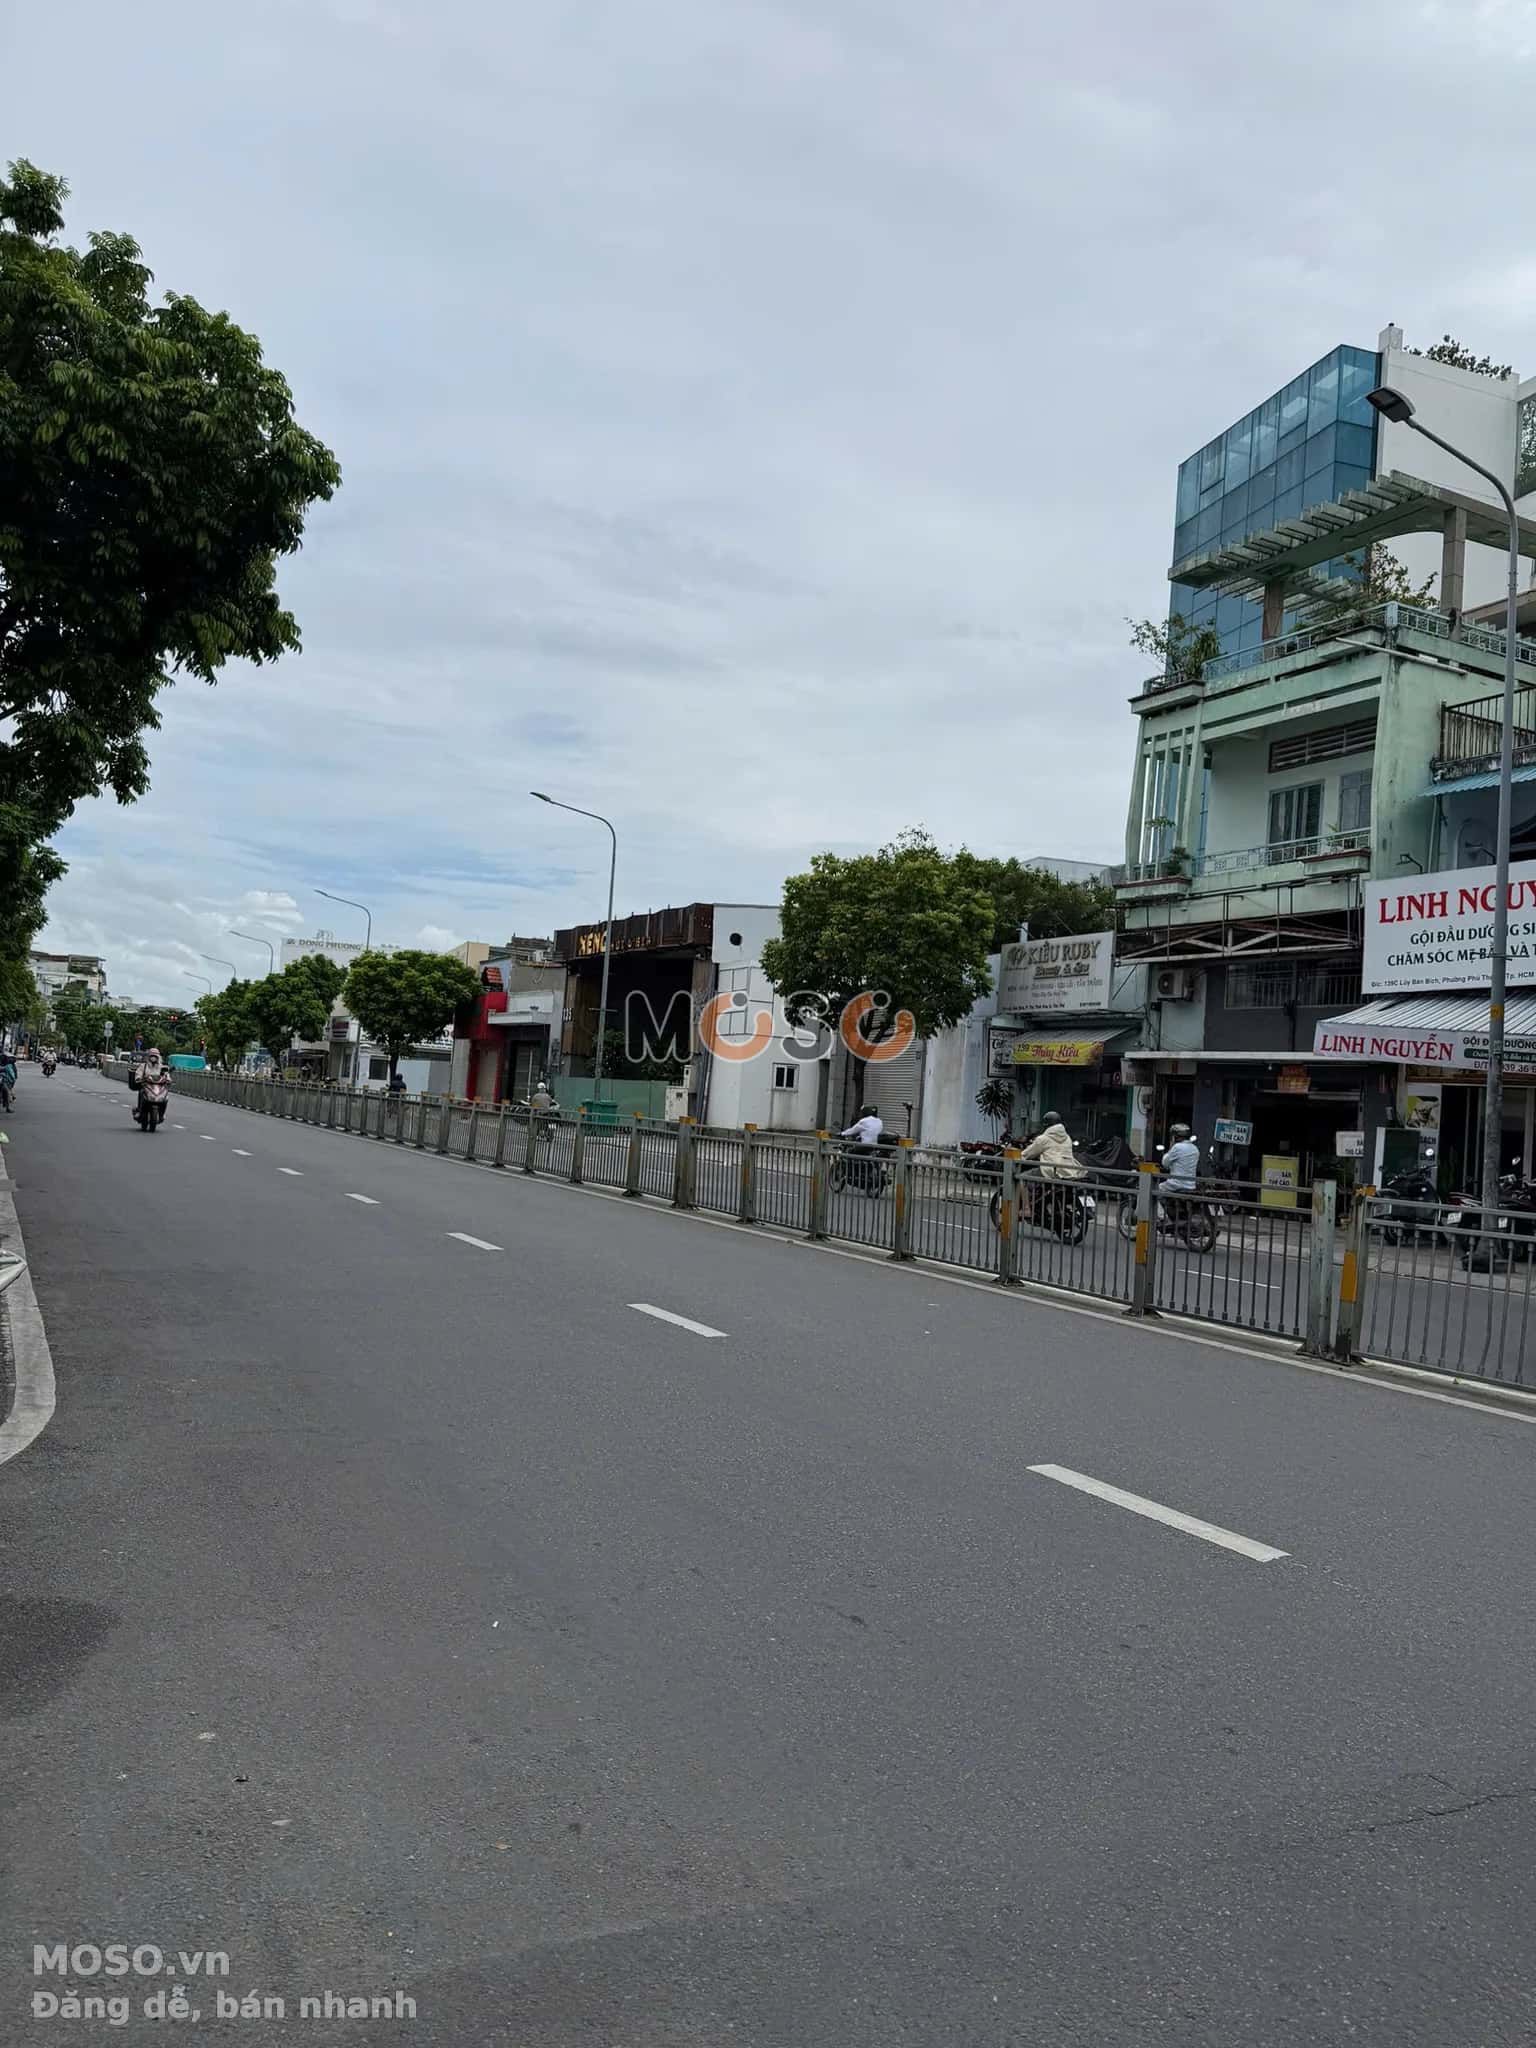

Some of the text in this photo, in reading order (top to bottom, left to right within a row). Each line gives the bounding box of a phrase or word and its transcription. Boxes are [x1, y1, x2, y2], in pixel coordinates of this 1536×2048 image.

[1379, 891, 1448, 923] LINH
[1410, 930, 1434, 947] GỘI
[1437, 925, 1465, 943] ĐẦU
[1468, 922, 1519, 940] DƯỠG
[1062, 940, 1101, 962] RUBY
[1427, 949, 1453, 965] SÓC
[1321, 1032, 1454, 1061] LINH NGUYỄN
